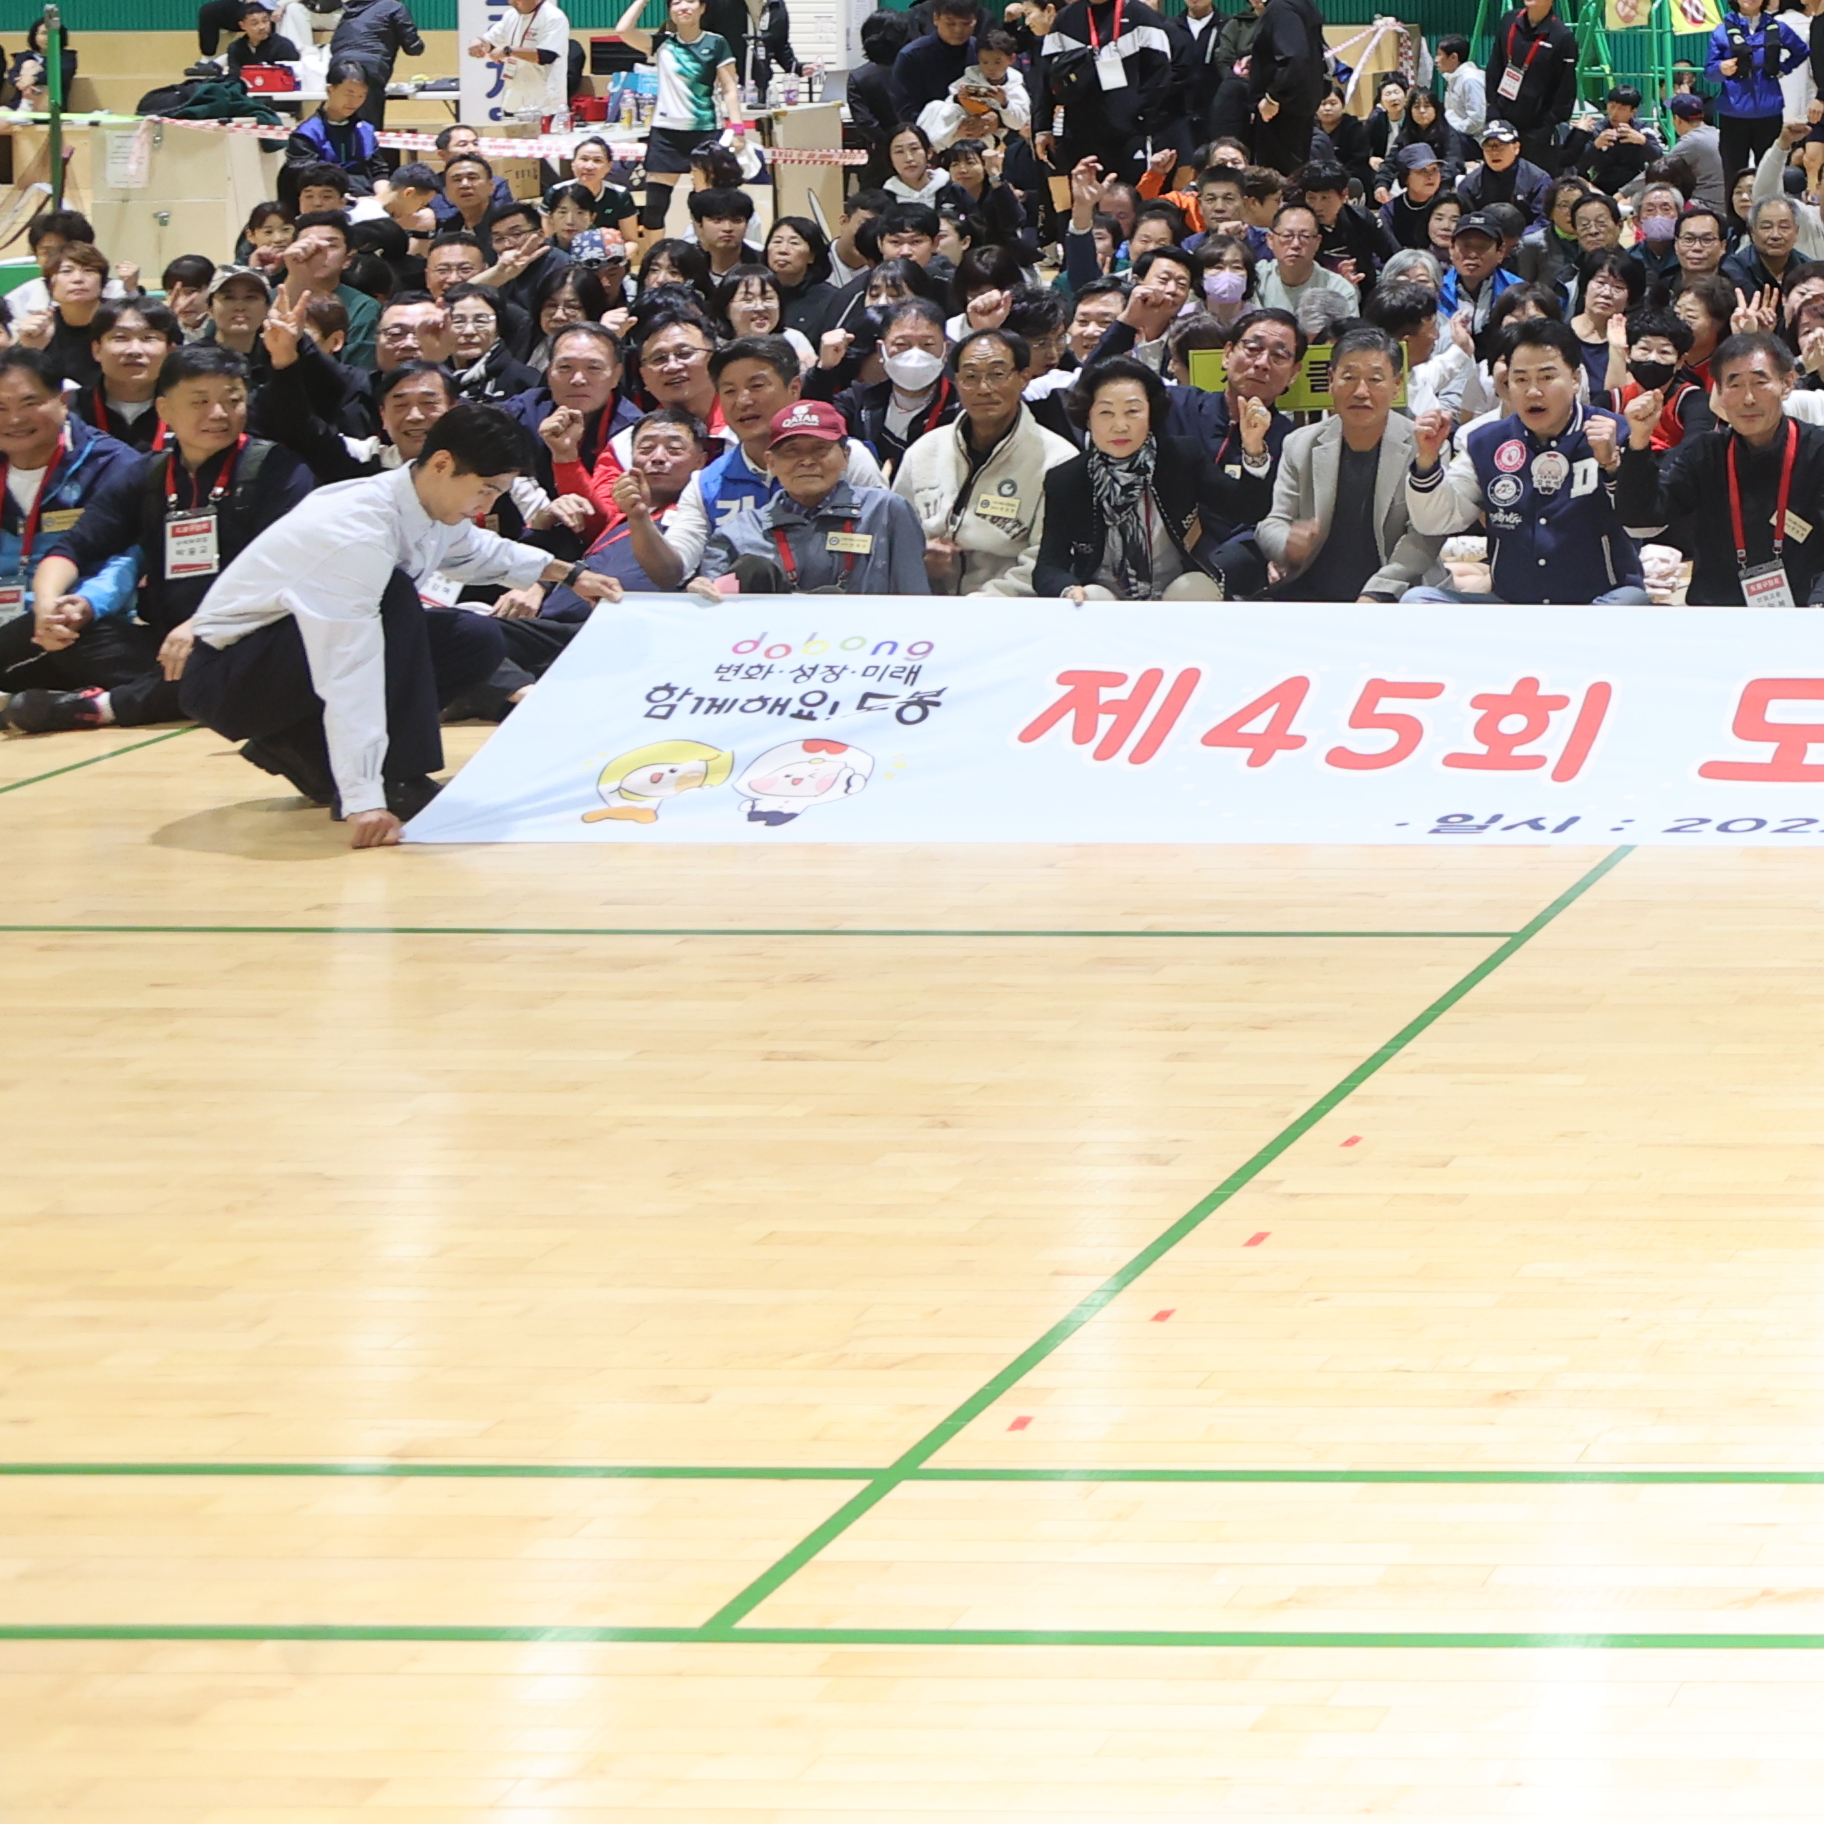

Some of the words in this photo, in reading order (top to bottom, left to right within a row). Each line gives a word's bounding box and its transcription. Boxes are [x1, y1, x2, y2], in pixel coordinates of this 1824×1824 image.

[781, 413, 821, 428] QATAR
[1570, 457, 1599, 498] D
[731, 631, 935, 661] dobong
[714, 662, 923, 686] 변화·성장·미래
[643, 682, 841, 721] 함께해요!
[1018, 667, 1613, 784] 제45회
[1428, 813, 1581, 834] 일시
